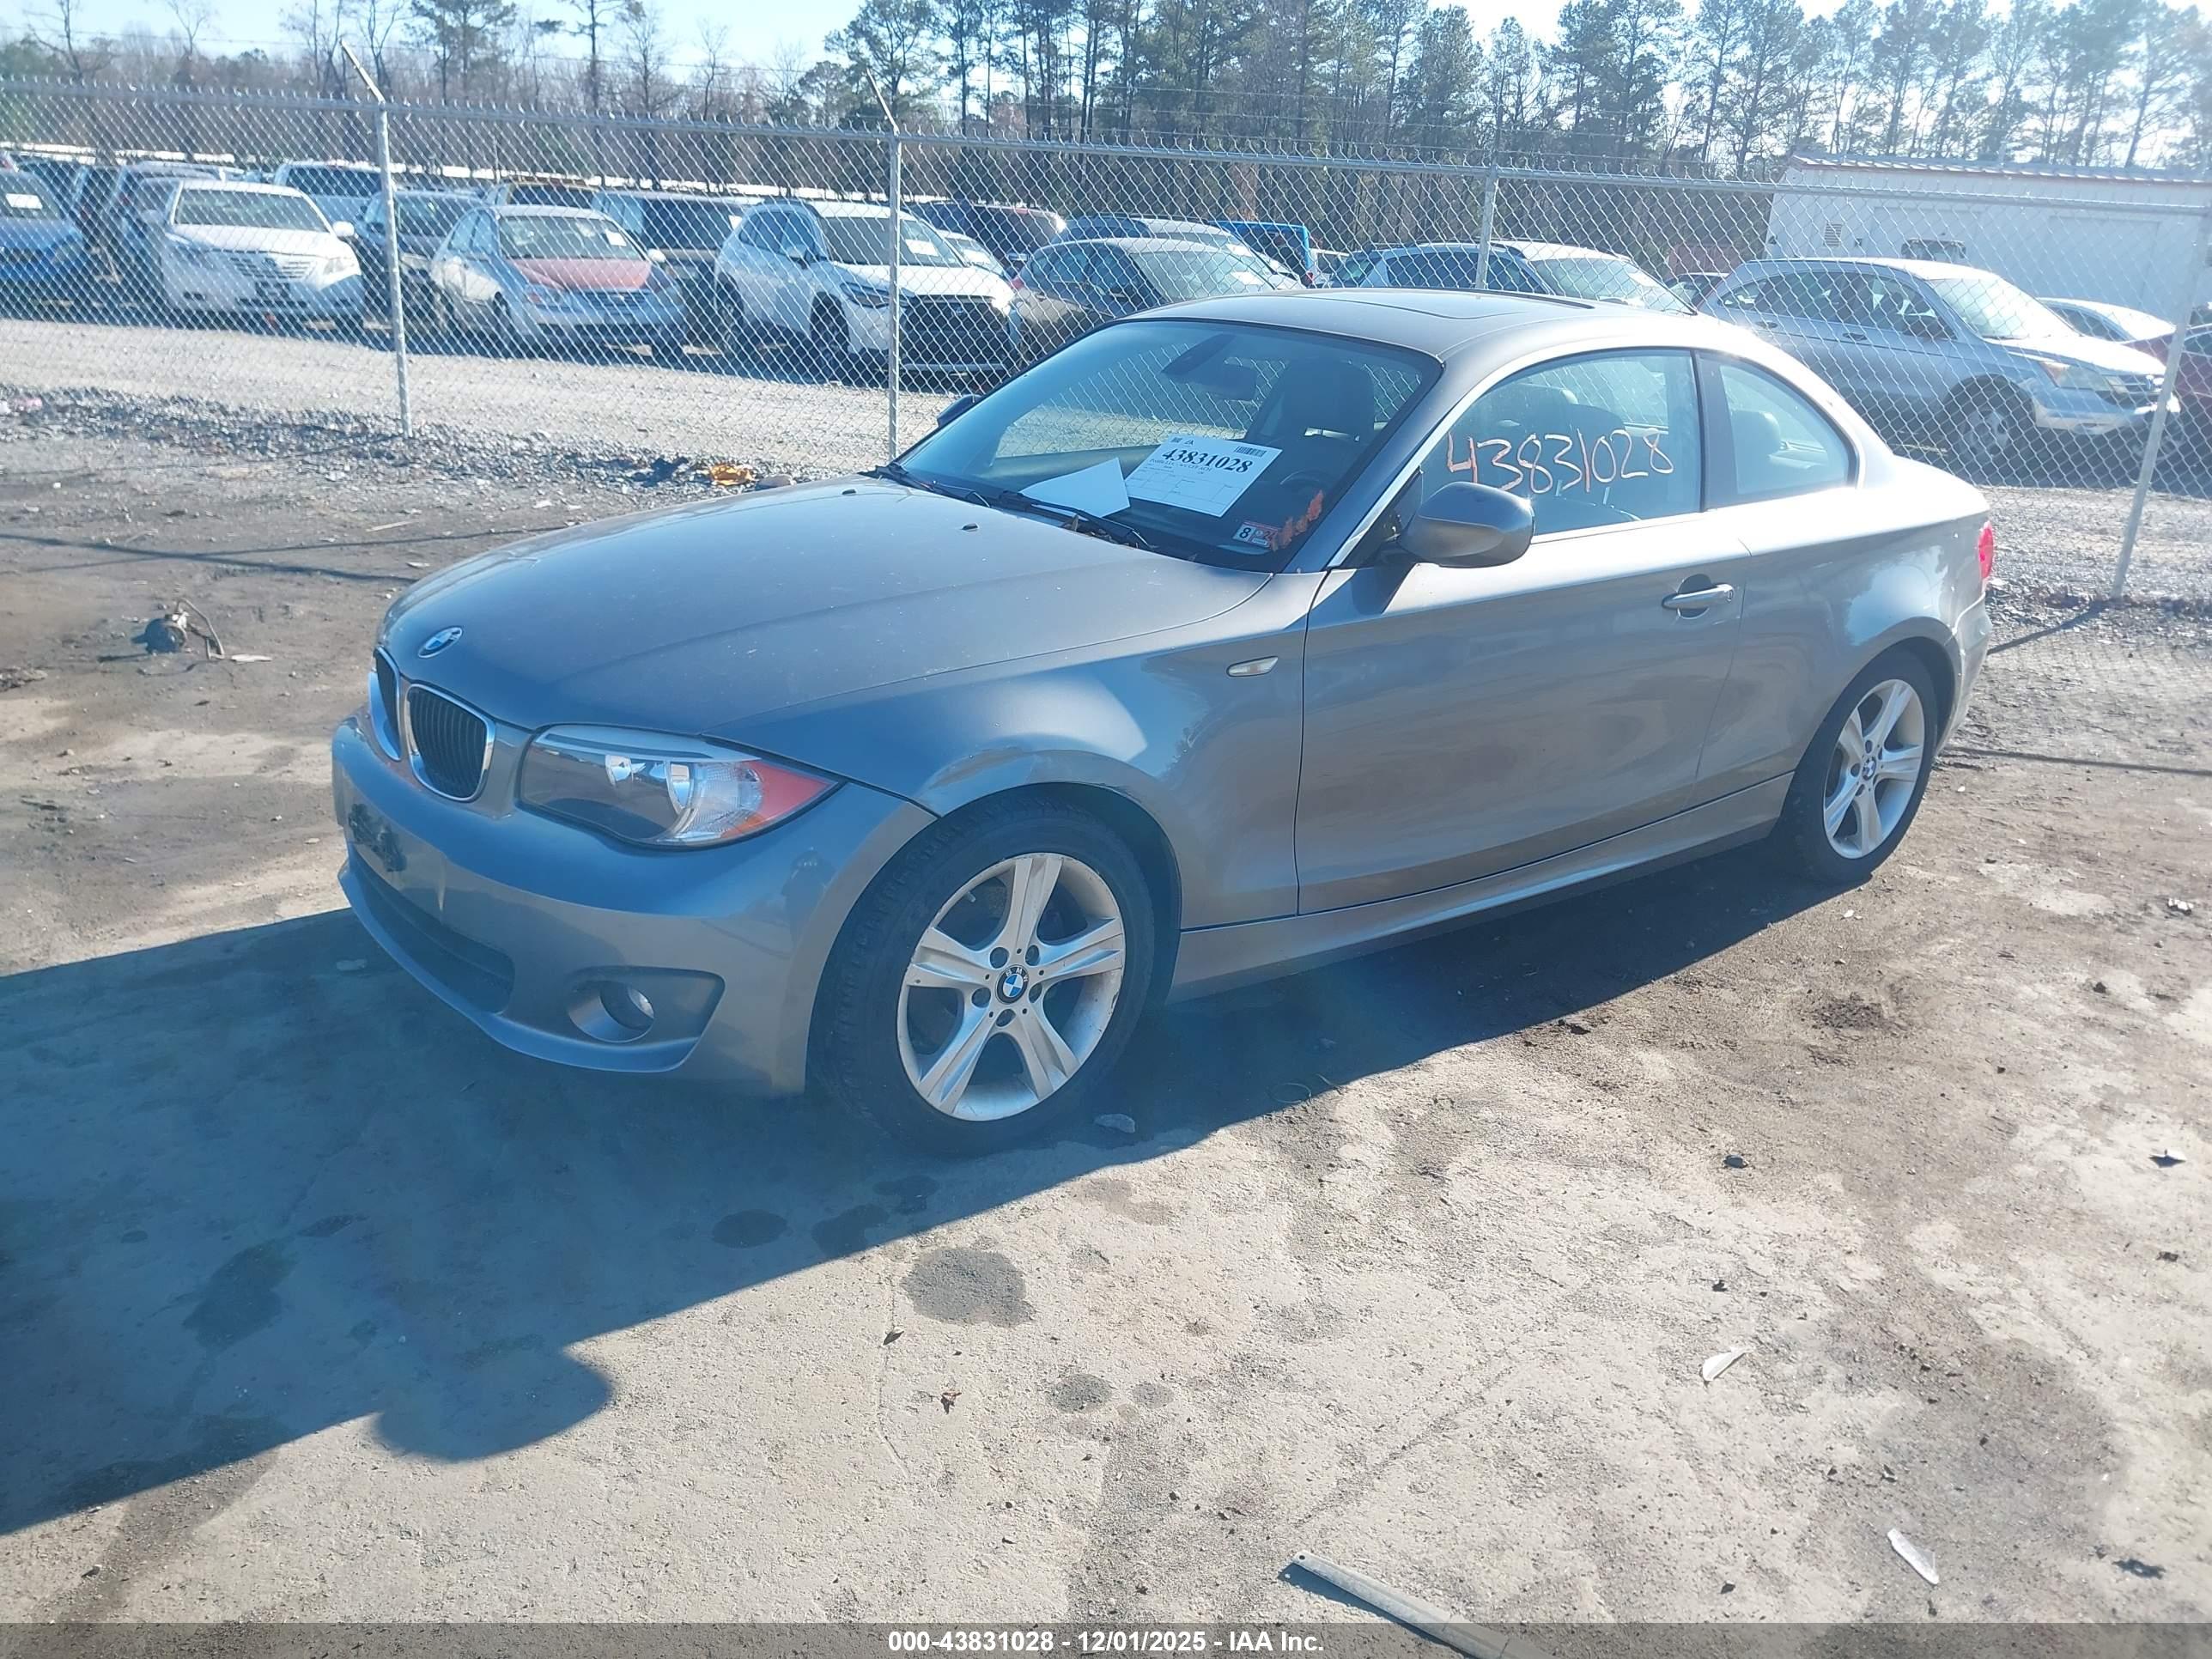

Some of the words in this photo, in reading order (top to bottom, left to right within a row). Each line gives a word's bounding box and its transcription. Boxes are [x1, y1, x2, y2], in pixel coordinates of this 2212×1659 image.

[1162, 448, 1253, 473] 43831028
[1447, 428, 1675, 495] 43831028
[1239, 527, 1251, 538] 8
[1006, 968, 1029, 982] BMW
